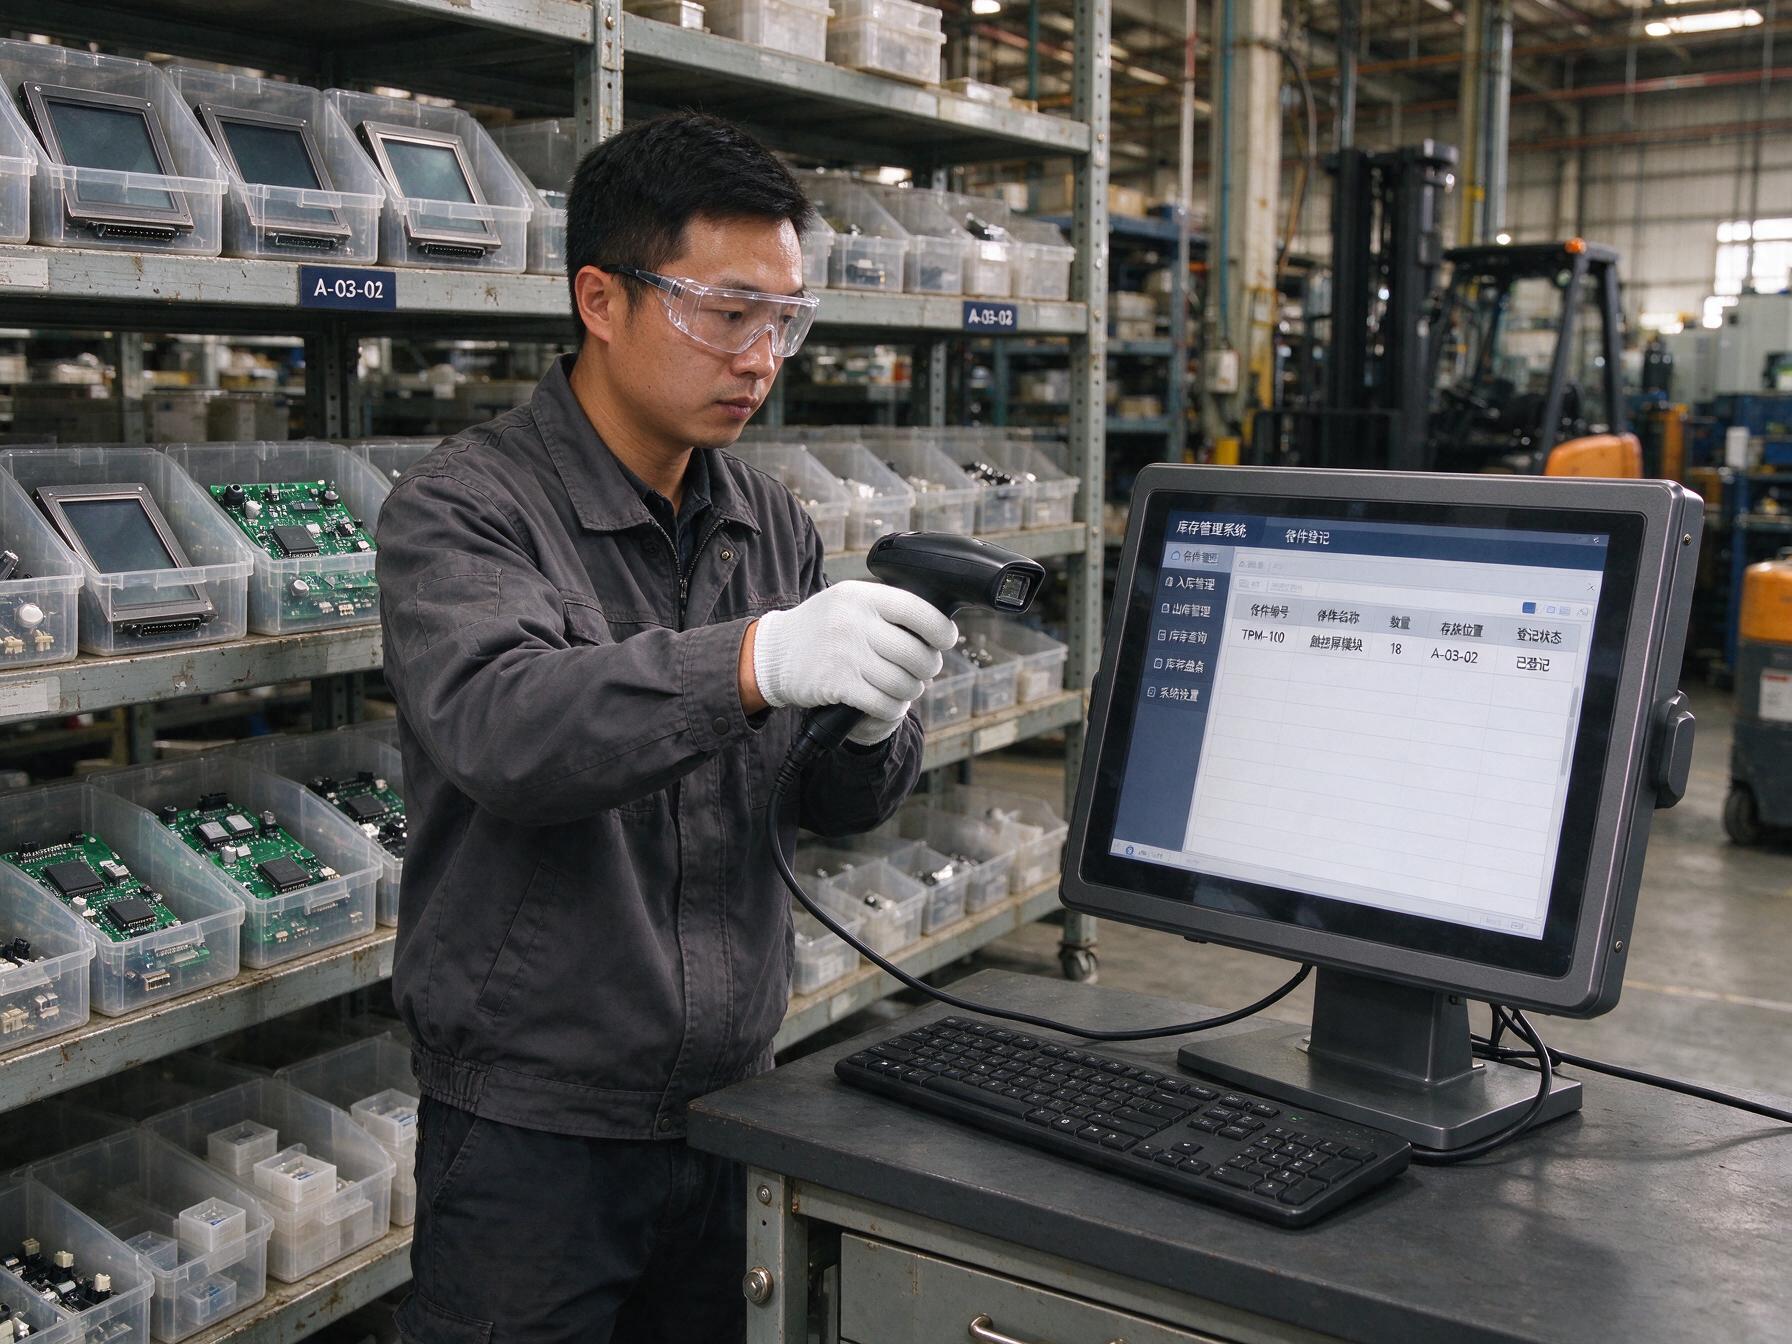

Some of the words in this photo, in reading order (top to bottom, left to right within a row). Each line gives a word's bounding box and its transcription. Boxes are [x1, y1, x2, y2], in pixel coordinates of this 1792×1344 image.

[314, 278, 383, 298] A-03-02
[968, 308, 1013, 326] A-03-02
[1176, 520, 1247, 538] 库存管理系统
[1517, 627, 1562, 645] 登记状态
[1241, 628, 1285, 643] TPM-100
[1391, 643, 1402, 655] 18
[1431, 648, 1479, 664] A-03-02
[1516, 656, 1550, 672] 已登记
